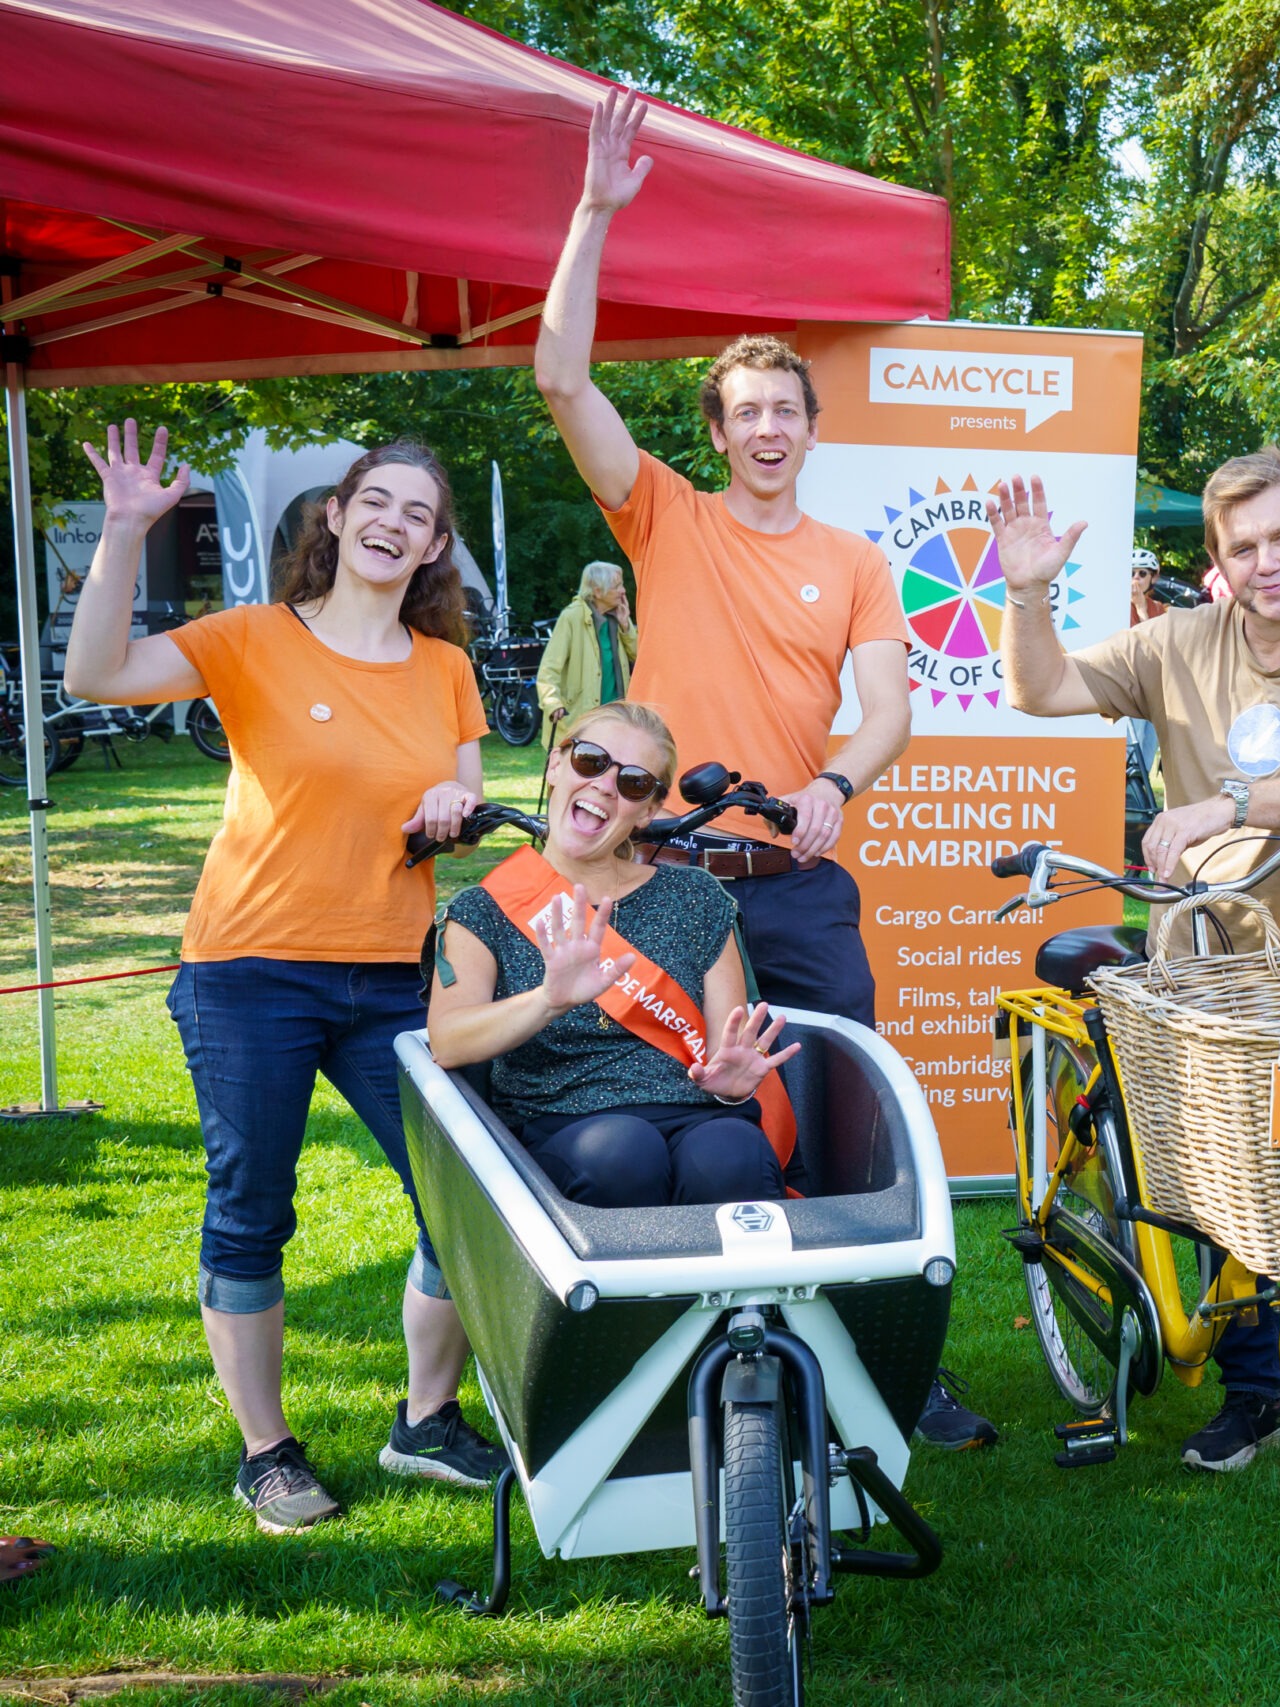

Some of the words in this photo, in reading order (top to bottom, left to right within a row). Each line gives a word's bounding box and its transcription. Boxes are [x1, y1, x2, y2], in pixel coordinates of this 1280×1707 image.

[883, 363, 1060, 396] CAMCYCLE
[950, 415, 1017, 430] presents
[54, 528, 103, 544] linto
[950, 666, 983, 686] OF
[872, 765, 1077, 793] ELEBRATING
[867, 803, 1012, 830] CYCLING
[1022, 803, 1056, 830] IN
[875, 905, 942, 929] Cargo
[897, 946, 962, 967] Social
[968, 946, 1022, 966] rides
[898, 987, 962, 1008] Films,
